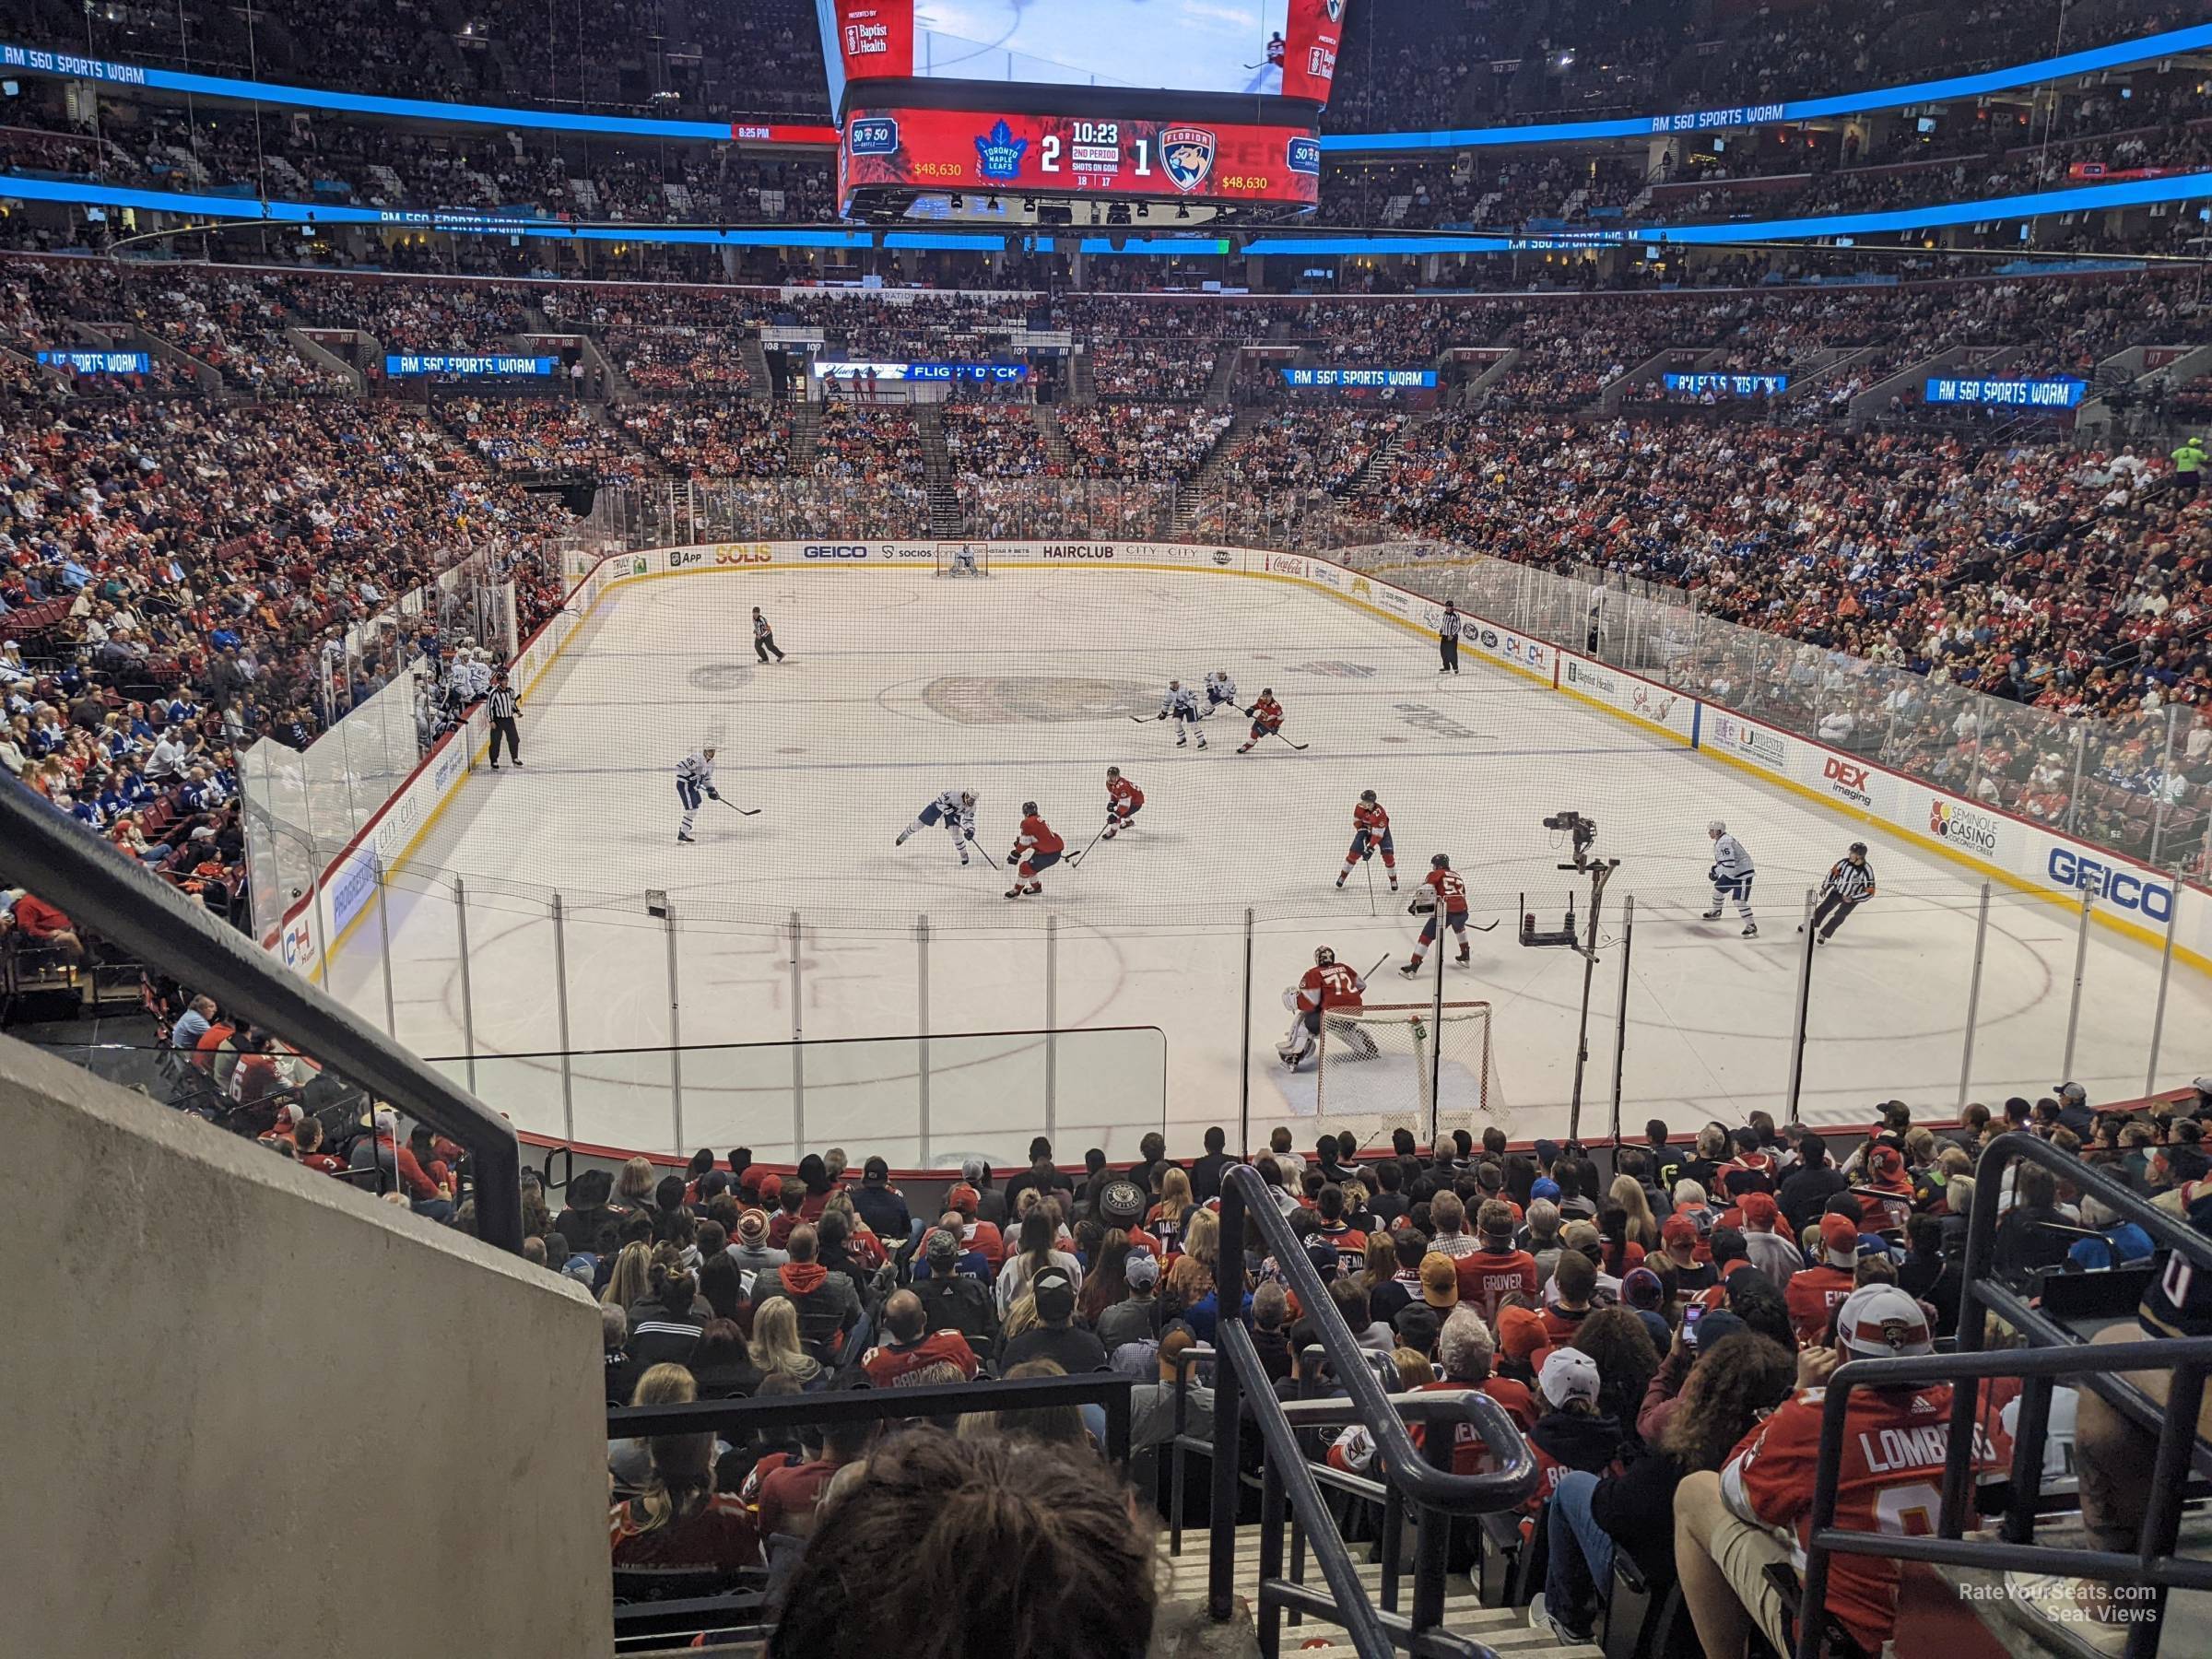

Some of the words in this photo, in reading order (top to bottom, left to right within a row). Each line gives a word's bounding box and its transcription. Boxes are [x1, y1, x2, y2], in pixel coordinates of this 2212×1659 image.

[859, 23, 887, 40] Baptist
[861, 39, 887, 53] Health
[5, 46, 25, 66] AM
[29, 51, 53, 70] 560
[57, 55, 103, 78] SPORTS
[107, 63, 145, 85] WQAM
[1653, 117, 1669, 132] AM
[1674, 114, 1694, 130] 560
[1699, 108, 1742, 128] SPORTS
[1747, 103, 1783, 123] WQAM
[738, 127, 756, 138] 8:25
[756, 128, 770, 138] PM
[873, 128, 888, 141] 50
[1072, 122, 1118, 144] 10:23
[1167, 132, 1207, 146] FLORIDA
[982, 146, 1018, 159] TORONTO
[989, 155, 1013, 164] MAPLE
[1041, 135, 1060, 172] 2
[1073, 147, 1088, 158] 2ND
[1089, 147, 1116, 159] PERIOD
[1135, 139, 1151, 176] 1
[914, 162, 962, 178] $48,630
[989, 161, 1013, 171] LEAFS
[1072, 162, 1092, 172] SHOTS
[1093, 162, 1101, 172] ON
[1103, 163, 1118, 173] GOAL
[1078, 175, 1088, 185] 18
[1101, 176, 1111, 187] 17
[1222, 176, 1267, 190] $48,630
[763, 342, 779, 351] 108
[806, 342, 822, 352] 109
[107, 354, 137, 373] WQAM
[401, 358, 418, 372] AM
[975, 367, 1018, 379] DCK
[1294, 371, 1312, 384] AM
[1342, 371, 1384, 385] SPORTS
[1389, 371, 1422, 386] WQAM
[1939, 380, 1955, 400] AM
[1959, 382, 1979, 401] 560
[1983, 382, 2026, 404] SPORTS
[2031, 382, 2068, 406] WQAM
[715, 544, 772, 565] SOLIS
[804, 546, 867, 559] GEICO
[1043, 546, 1113, 559] HAIRCLUB
[1126, 546, 1158, 555] CITY
[1168, 547, 1198, 558] CITY
[1212, 553, 1232, 562] NHL
[1596, 675, 1615, 693] Health
[1823, 757, 1871, 793] DEX
[1832, 782, 1872, 806] imaging
[1951, 806, 1998, 835] SEMINOLE
[1949, 820, 1996, 850] CASINO
[1721, 847, 1731, 856] 16
[1948, 833, 1976, 852] COCONUT
[1975, 842, 1994, 858] CREEK
[2048, 847, 2173, 924] GEICO
[1323, 972, 1359, 995] 72
[1483, 1274, 1522, 1291] GROVER
